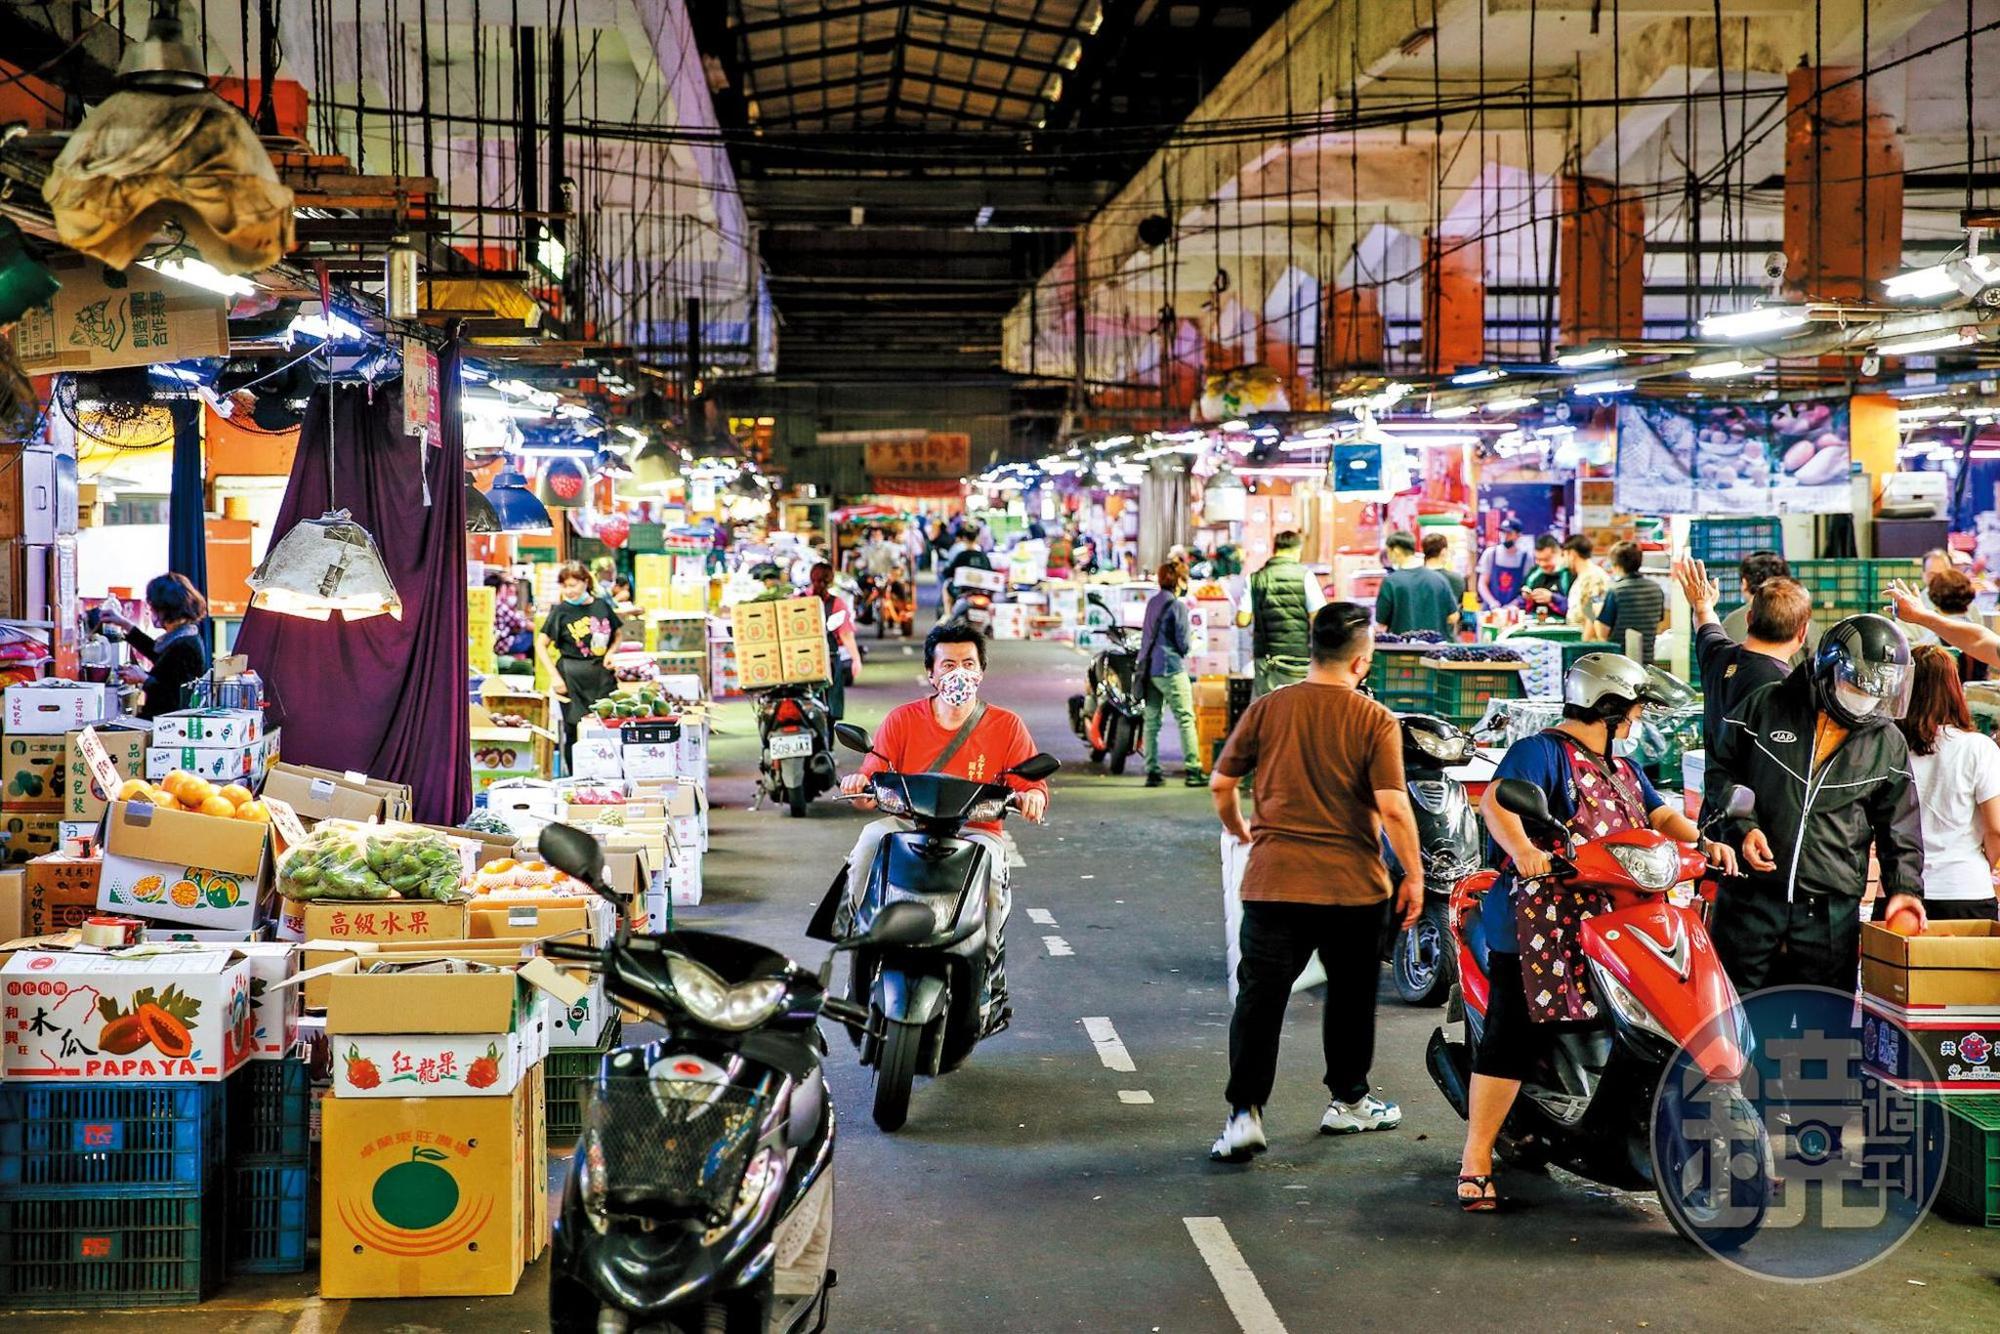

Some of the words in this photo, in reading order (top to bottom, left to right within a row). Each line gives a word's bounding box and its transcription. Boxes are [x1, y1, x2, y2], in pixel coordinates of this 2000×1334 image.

[127, 743, 142, 777] 品質
[329, 910, 430, 937] 高級水果
[28, 1007, 99, 1058] 木瓜
[86, 1060, 197, 1076] PAPAYA
